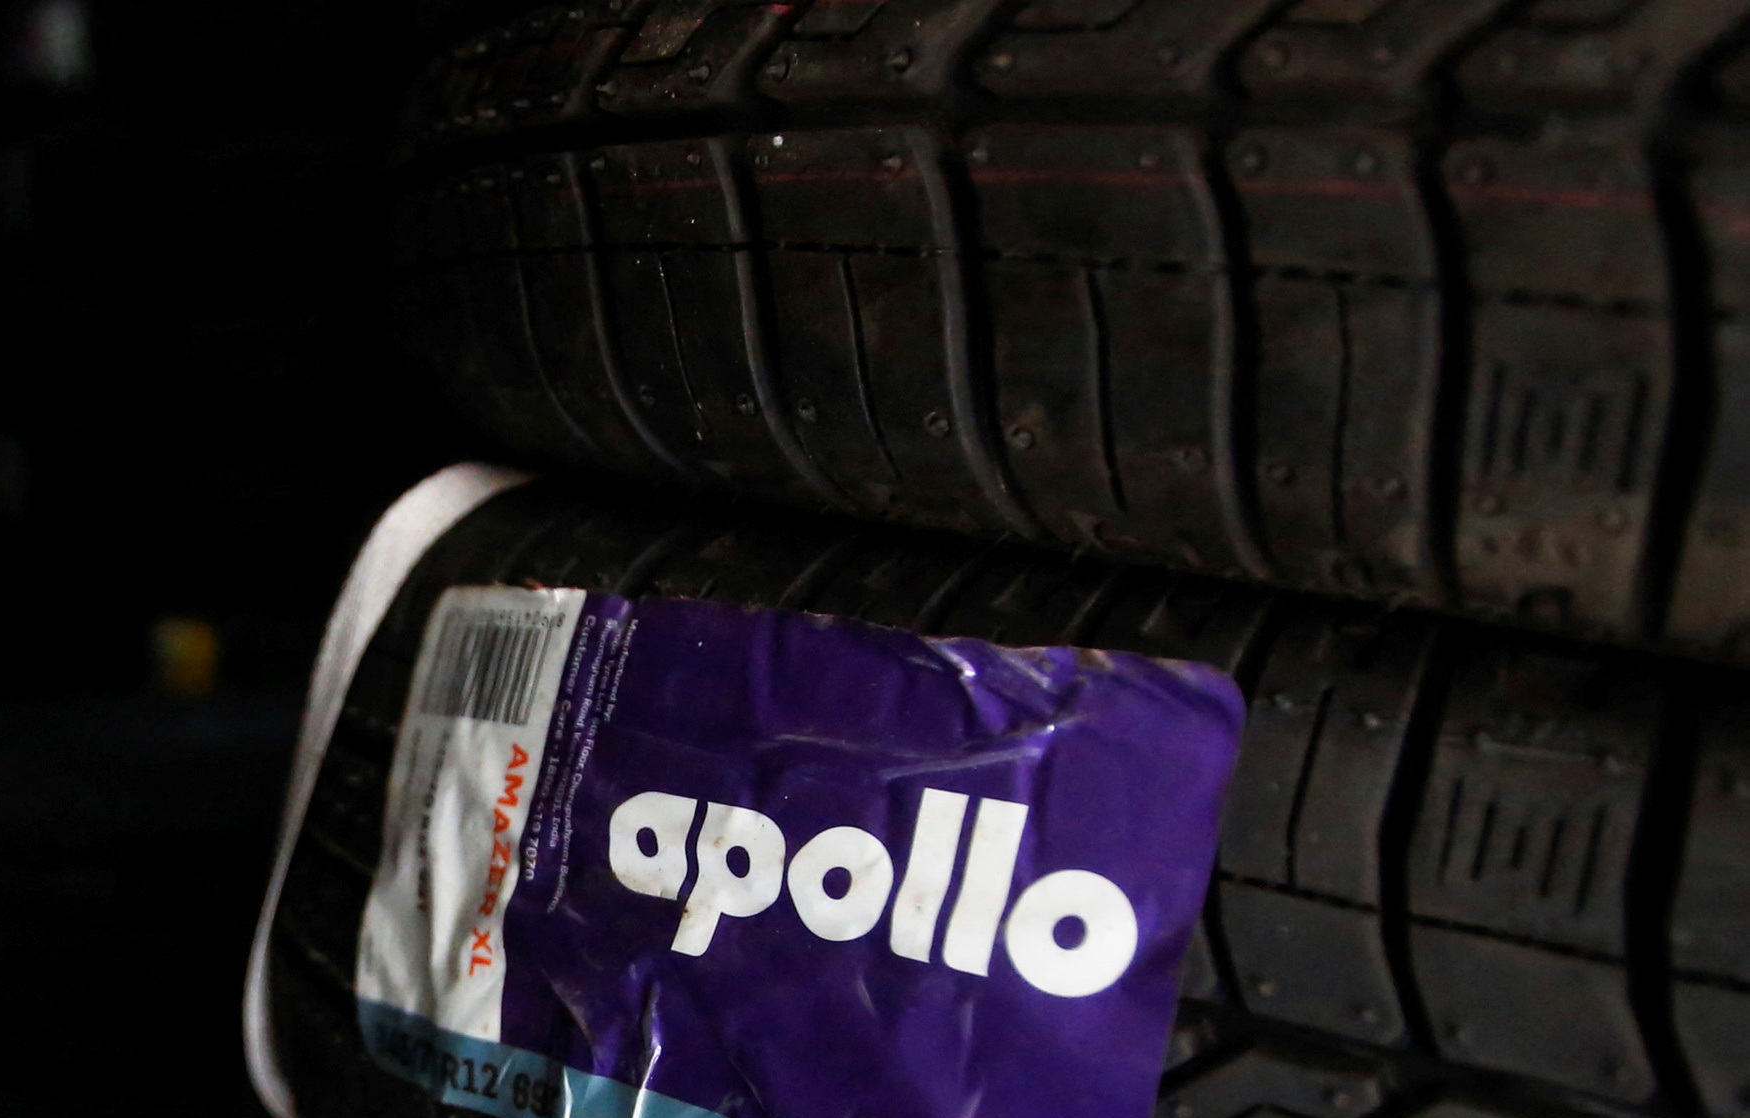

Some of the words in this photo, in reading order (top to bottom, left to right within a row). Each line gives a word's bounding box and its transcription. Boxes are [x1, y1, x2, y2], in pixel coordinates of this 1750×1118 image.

[564, 614, 597, 695] Customer
[609, 618, 639, 702] Manufactured
[555, 699, 571, 740] Care
[575, 737, 595, 770] Floor,
[479, 743, 529, 917] AMAZER
[550, 816, 562, 848] India
[609, 786, 1138, 998] apollo
[468, 926, 493, 976] XL
